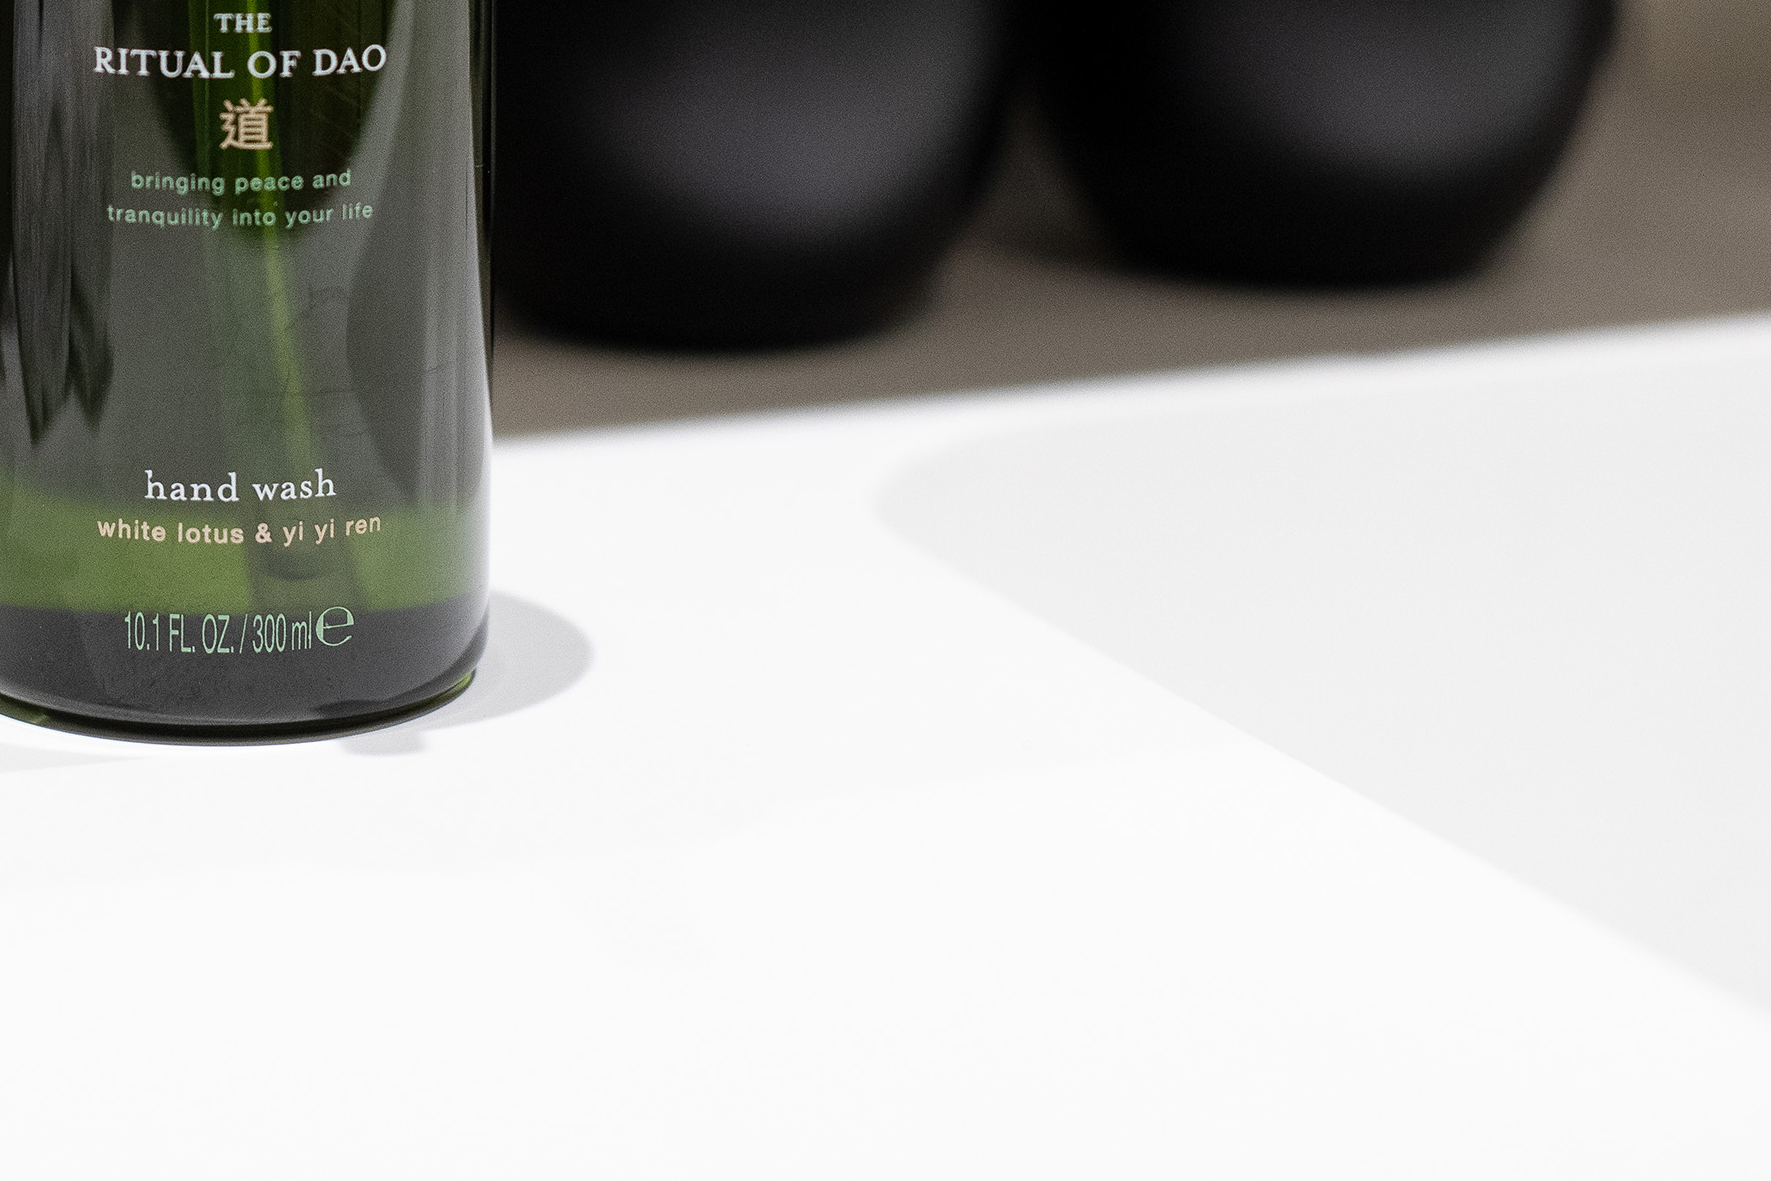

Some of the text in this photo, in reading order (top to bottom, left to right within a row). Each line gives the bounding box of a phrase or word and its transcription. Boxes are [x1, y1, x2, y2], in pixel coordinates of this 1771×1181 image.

[213, 12, 273, 34] THE
[93, 43, 388, 80] RITUAL OF DAO
[219, 97, 274, 150] 道
[130, 169, 352, 196] bringing peace and
[107, 202, 374, 230] tranquility into your life
[144, 467, 337, 502] hand wash
[96, 515, 382, 547] white lotus & yi yi ren
[124, 610, 160, 652] 10.1
[168, 613, 196, 653] FL.
[201, 613, 235, 654] OZ.
